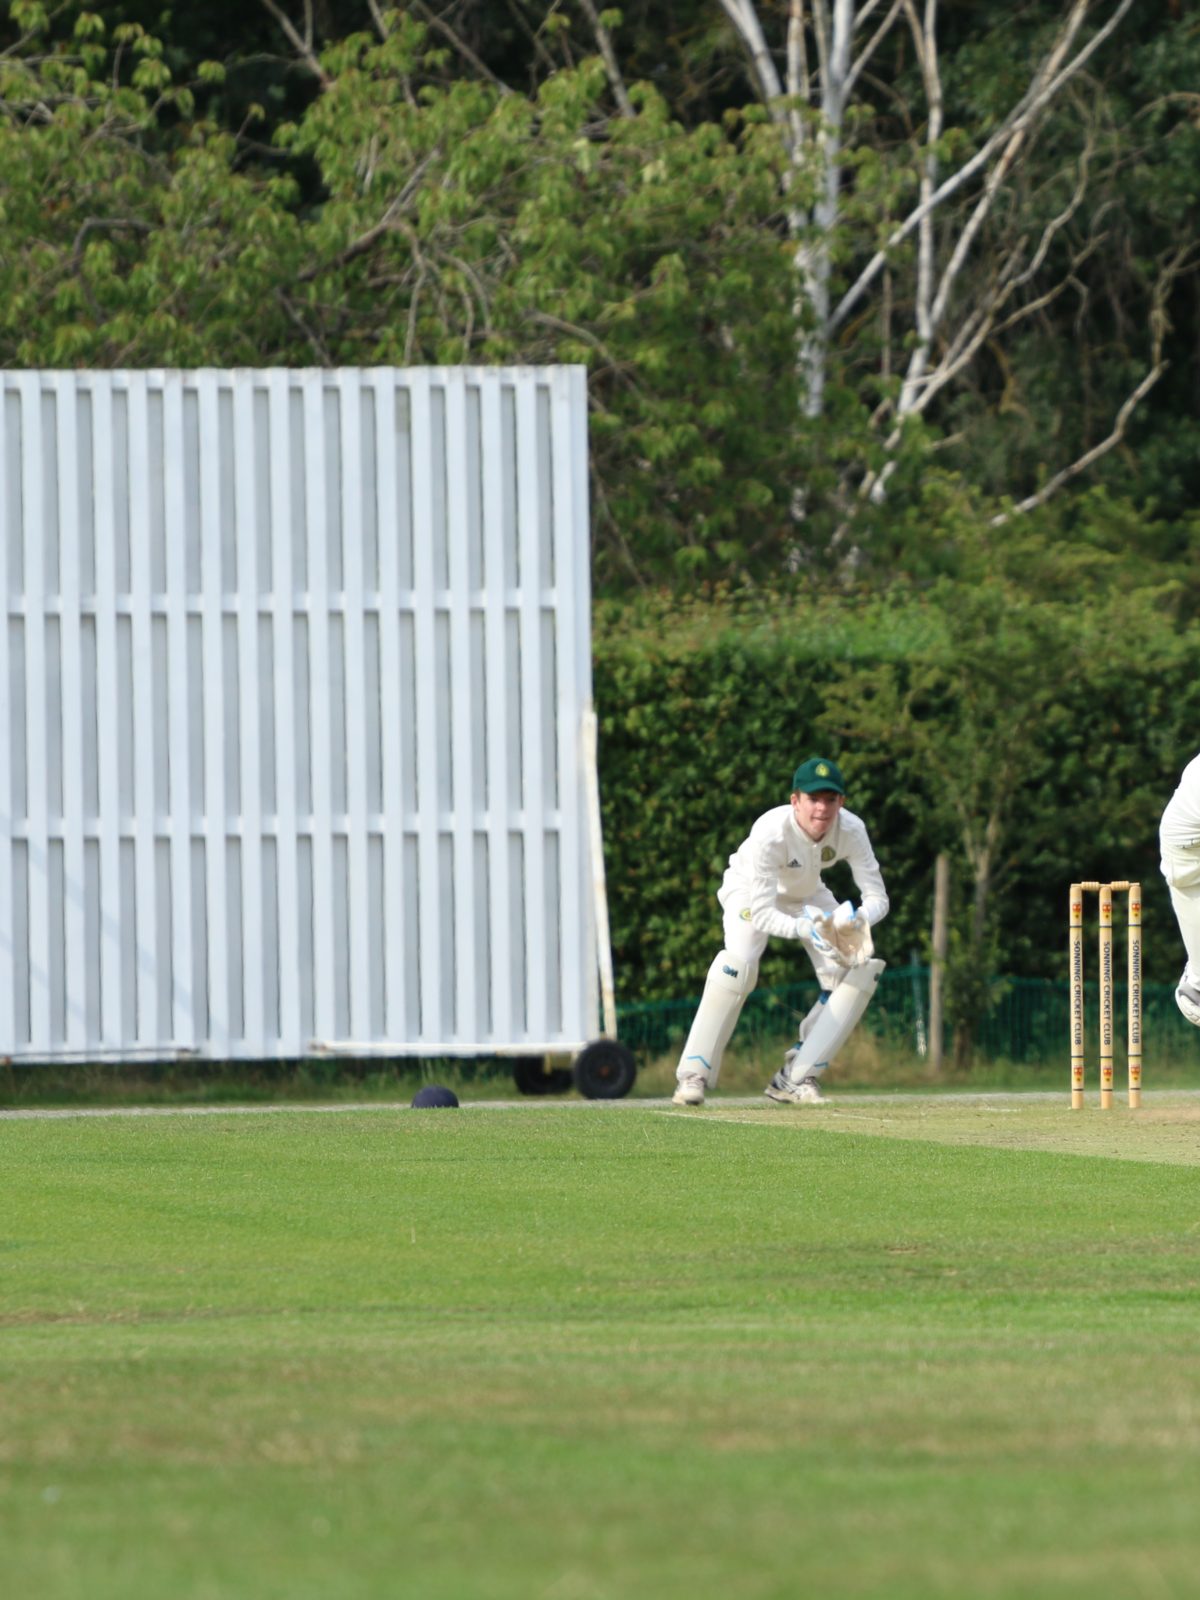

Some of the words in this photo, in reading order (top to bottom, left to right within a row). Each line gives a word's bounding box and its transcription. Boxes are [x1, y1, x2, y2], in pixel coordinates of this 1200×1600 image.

[1103, 942, 1111, 982] SONNING
[1132, 940, 1140, 981] SONNING
[1103, 985, 1111, 1020] CRICKET
[1132, 983, 1140, 1019] CRICKET
[1103, 1023, 1111, 1045] CLUB
[1132, 1022, 1140, 1044] CLUB
